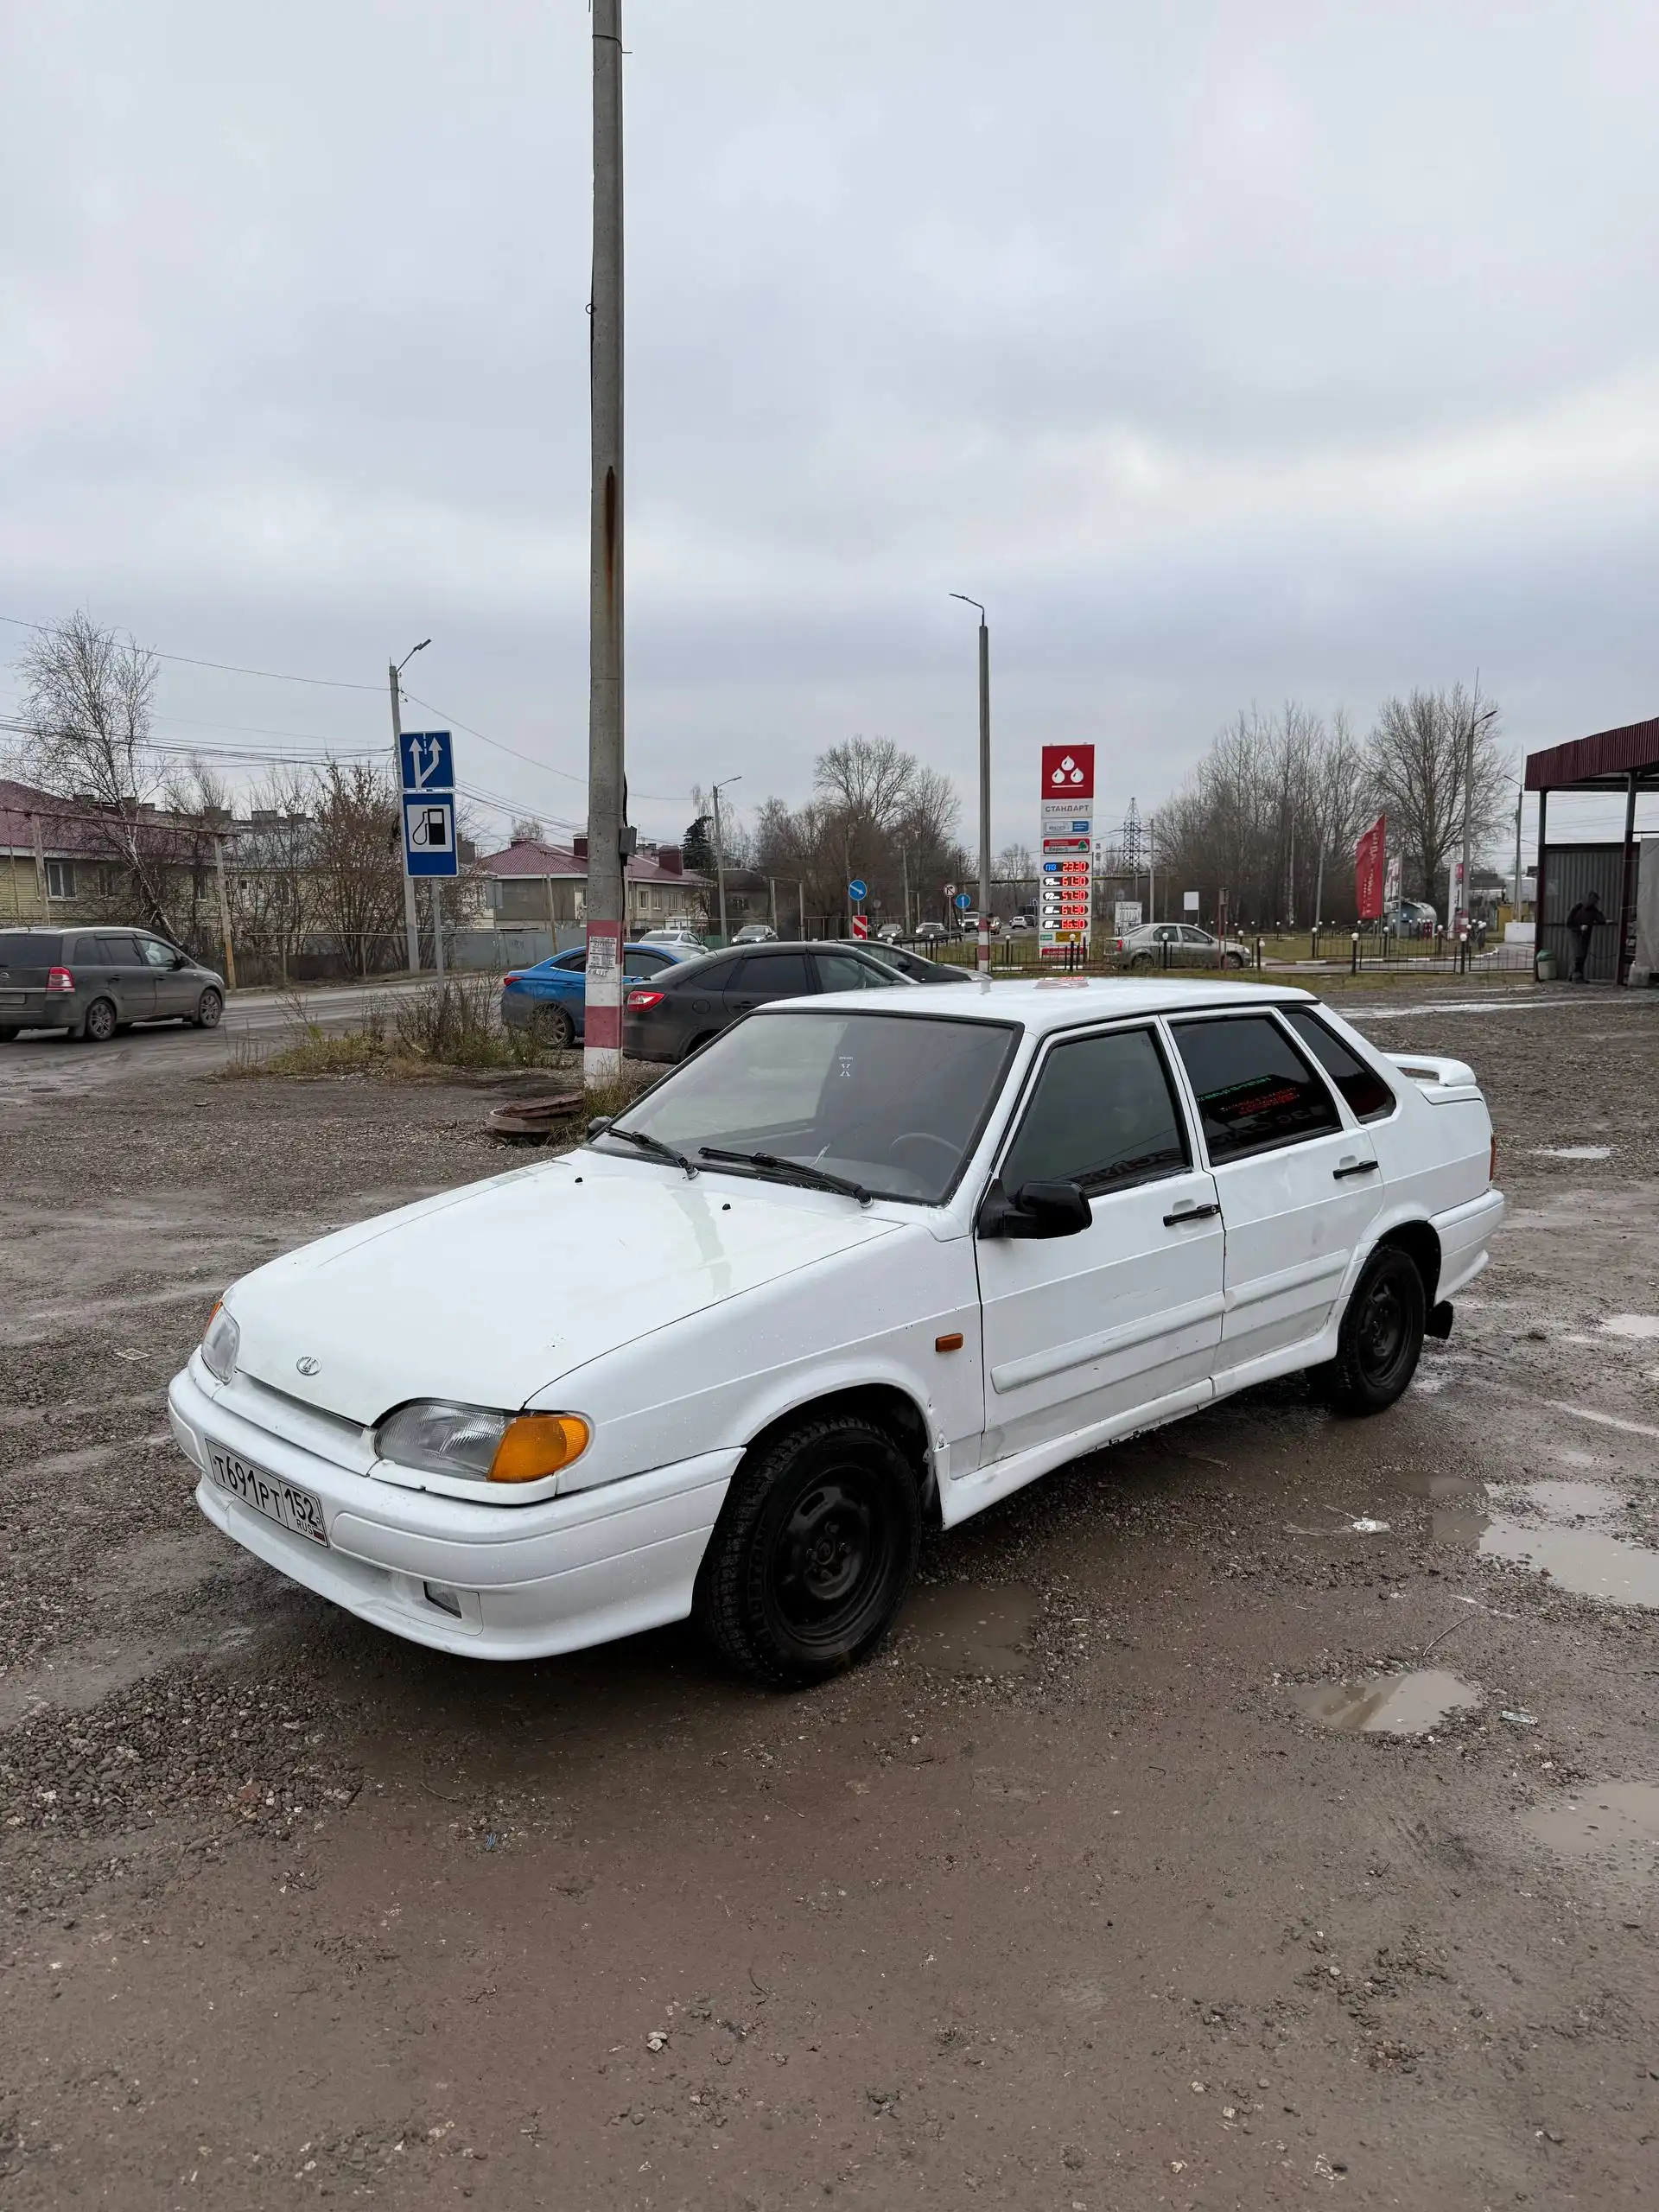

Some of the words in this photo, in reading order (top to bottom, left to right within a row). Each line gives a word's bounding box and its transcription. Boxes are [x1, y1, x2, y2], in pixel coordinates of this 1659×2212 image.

[1045, 804, 1090, 813] СТАНДАРТ
[1062, 861, 1086, 872] 23.30
[1062, 876, 1086, 887] 61.30
[1061, 891, 1086, 900] 57.30
[1061, 905, 1085, 915] 67.30
[1061, 919, 1085, 930] 66.30
[284, 1487, 318, 1526] 152
[296, 1518, 315, 1535] RUS
